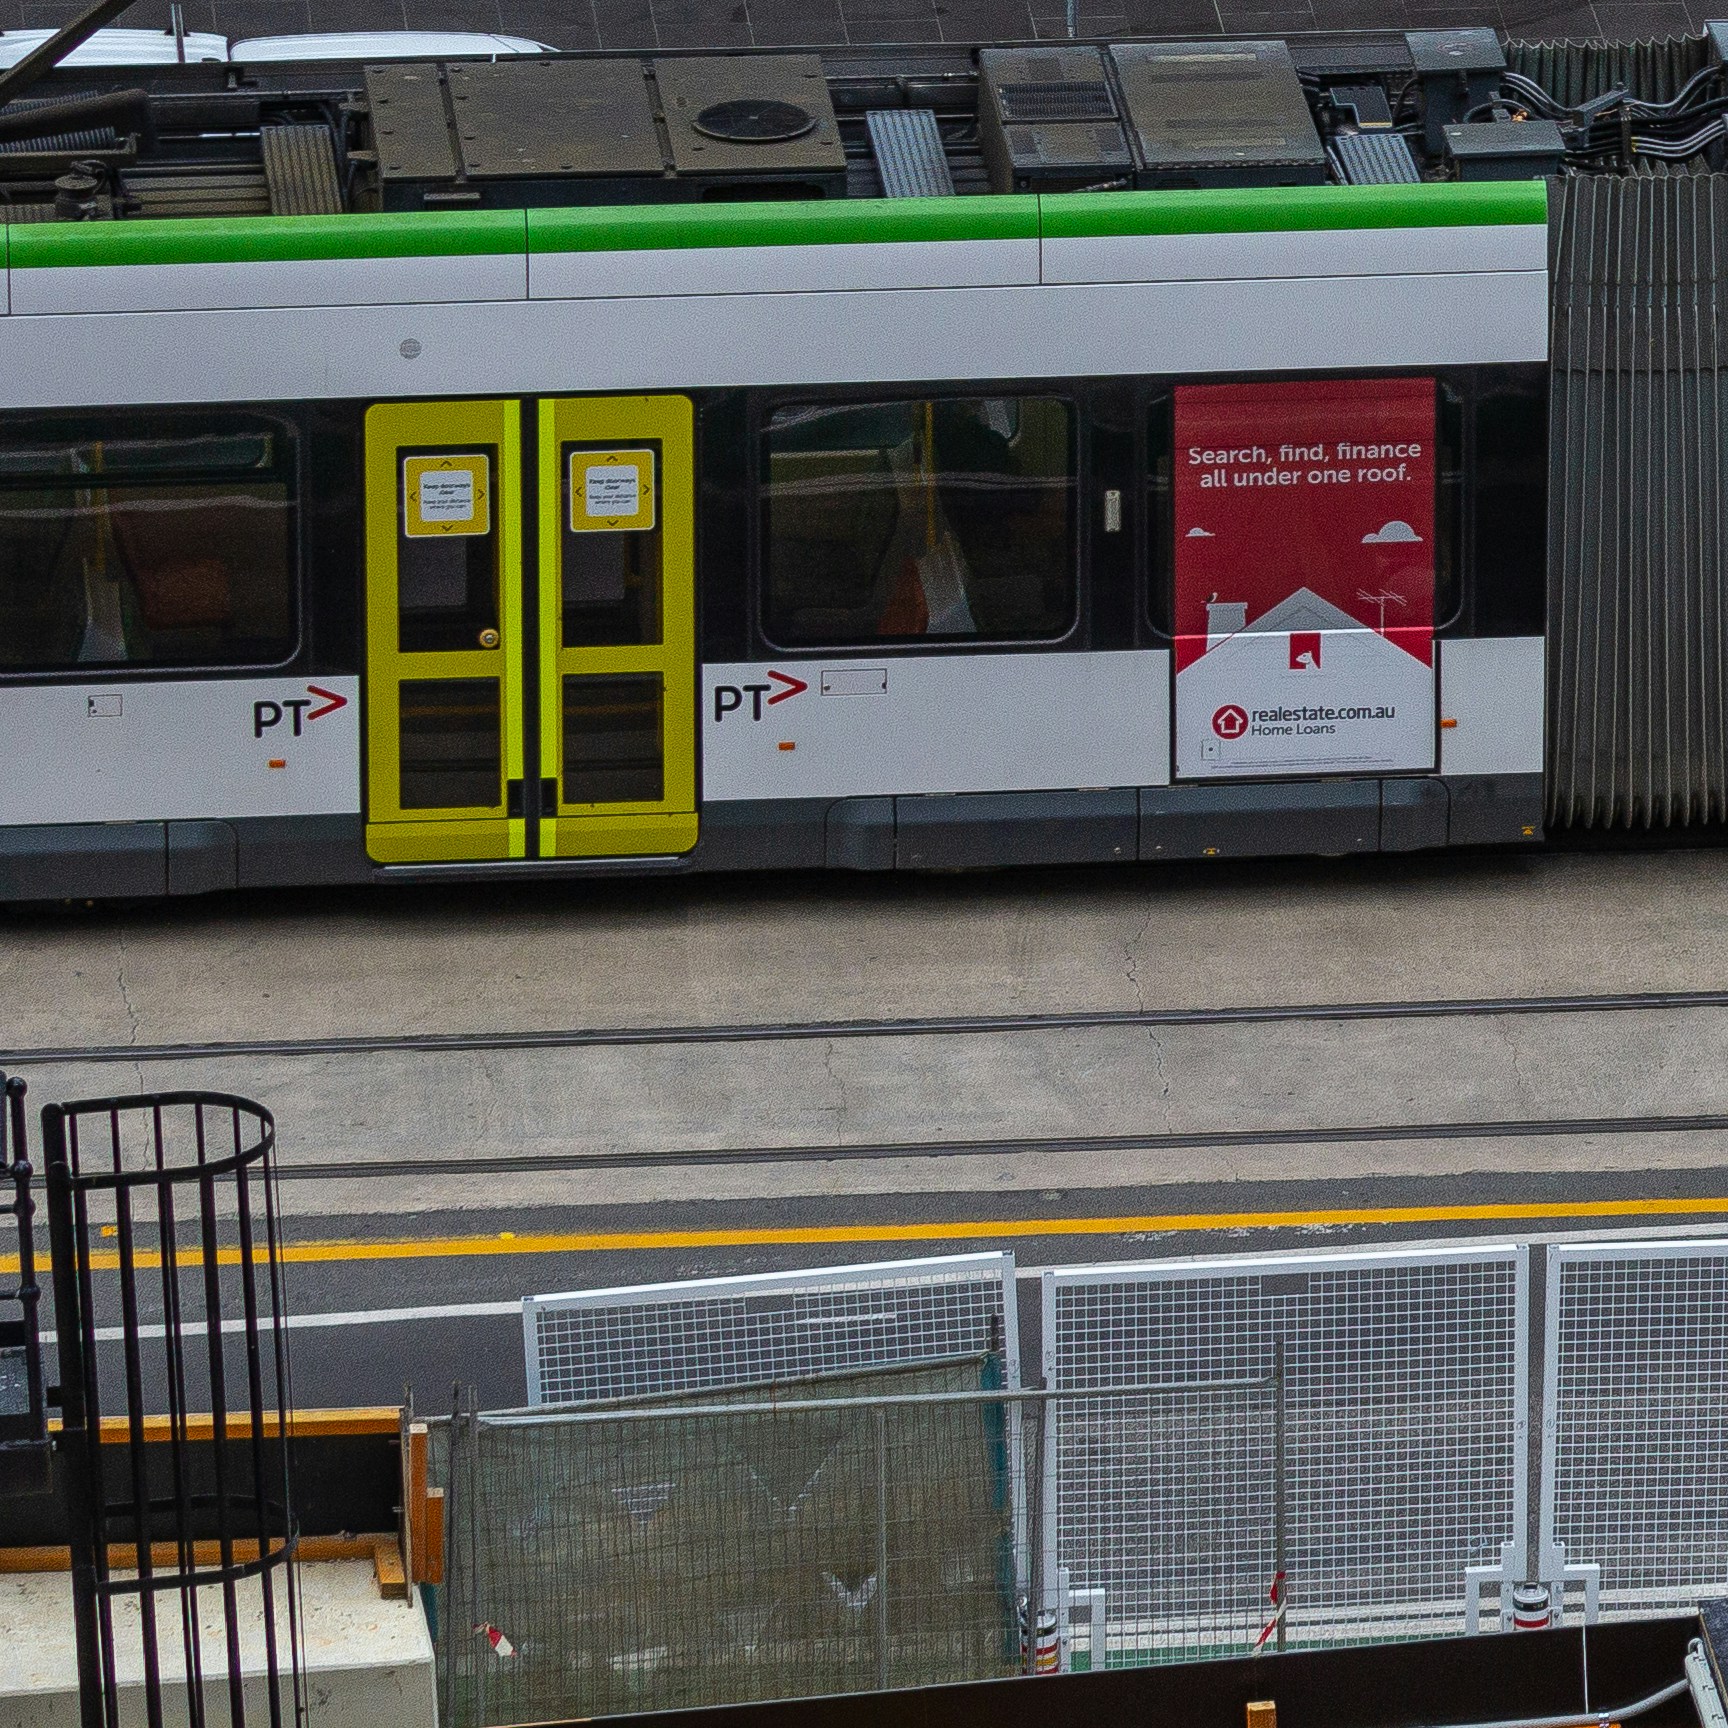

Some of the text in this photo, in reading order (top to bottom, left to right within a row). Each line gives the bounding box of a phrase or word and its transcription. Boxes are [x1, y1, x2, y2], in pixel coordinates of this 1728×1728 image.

[1188, 441, 1422, 466] Search, find, finance
[1200, 463, 1412, 487] all under one roof.
[1251, 706, 1396, 722] realestate.com.au
[1251, 724, 1336, 736] Home Loans
